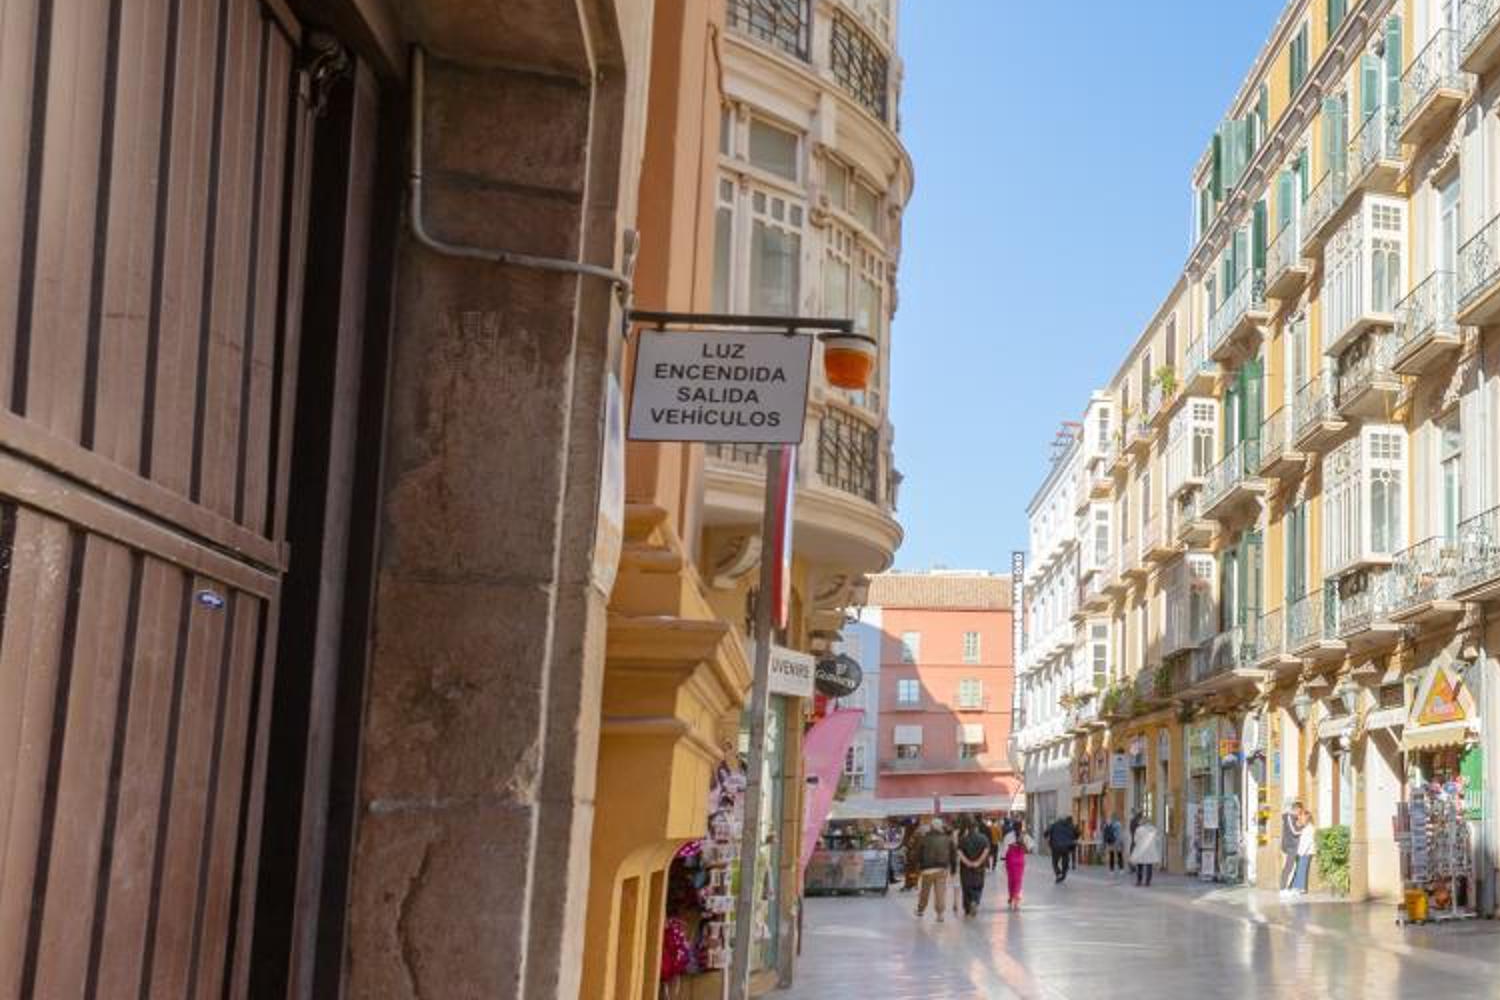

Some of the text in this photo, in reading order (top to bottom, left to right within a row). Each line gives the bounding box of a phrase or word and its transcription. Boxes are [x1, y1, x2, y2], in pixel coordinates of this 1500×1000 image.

[702, 343, 745, 359] LUZ
[655, 363, 786, 382] ENCENDIDA
[677, 387, 759, 404] SALIDA
[651, 406, 781, 427] VEHÍCULOS
